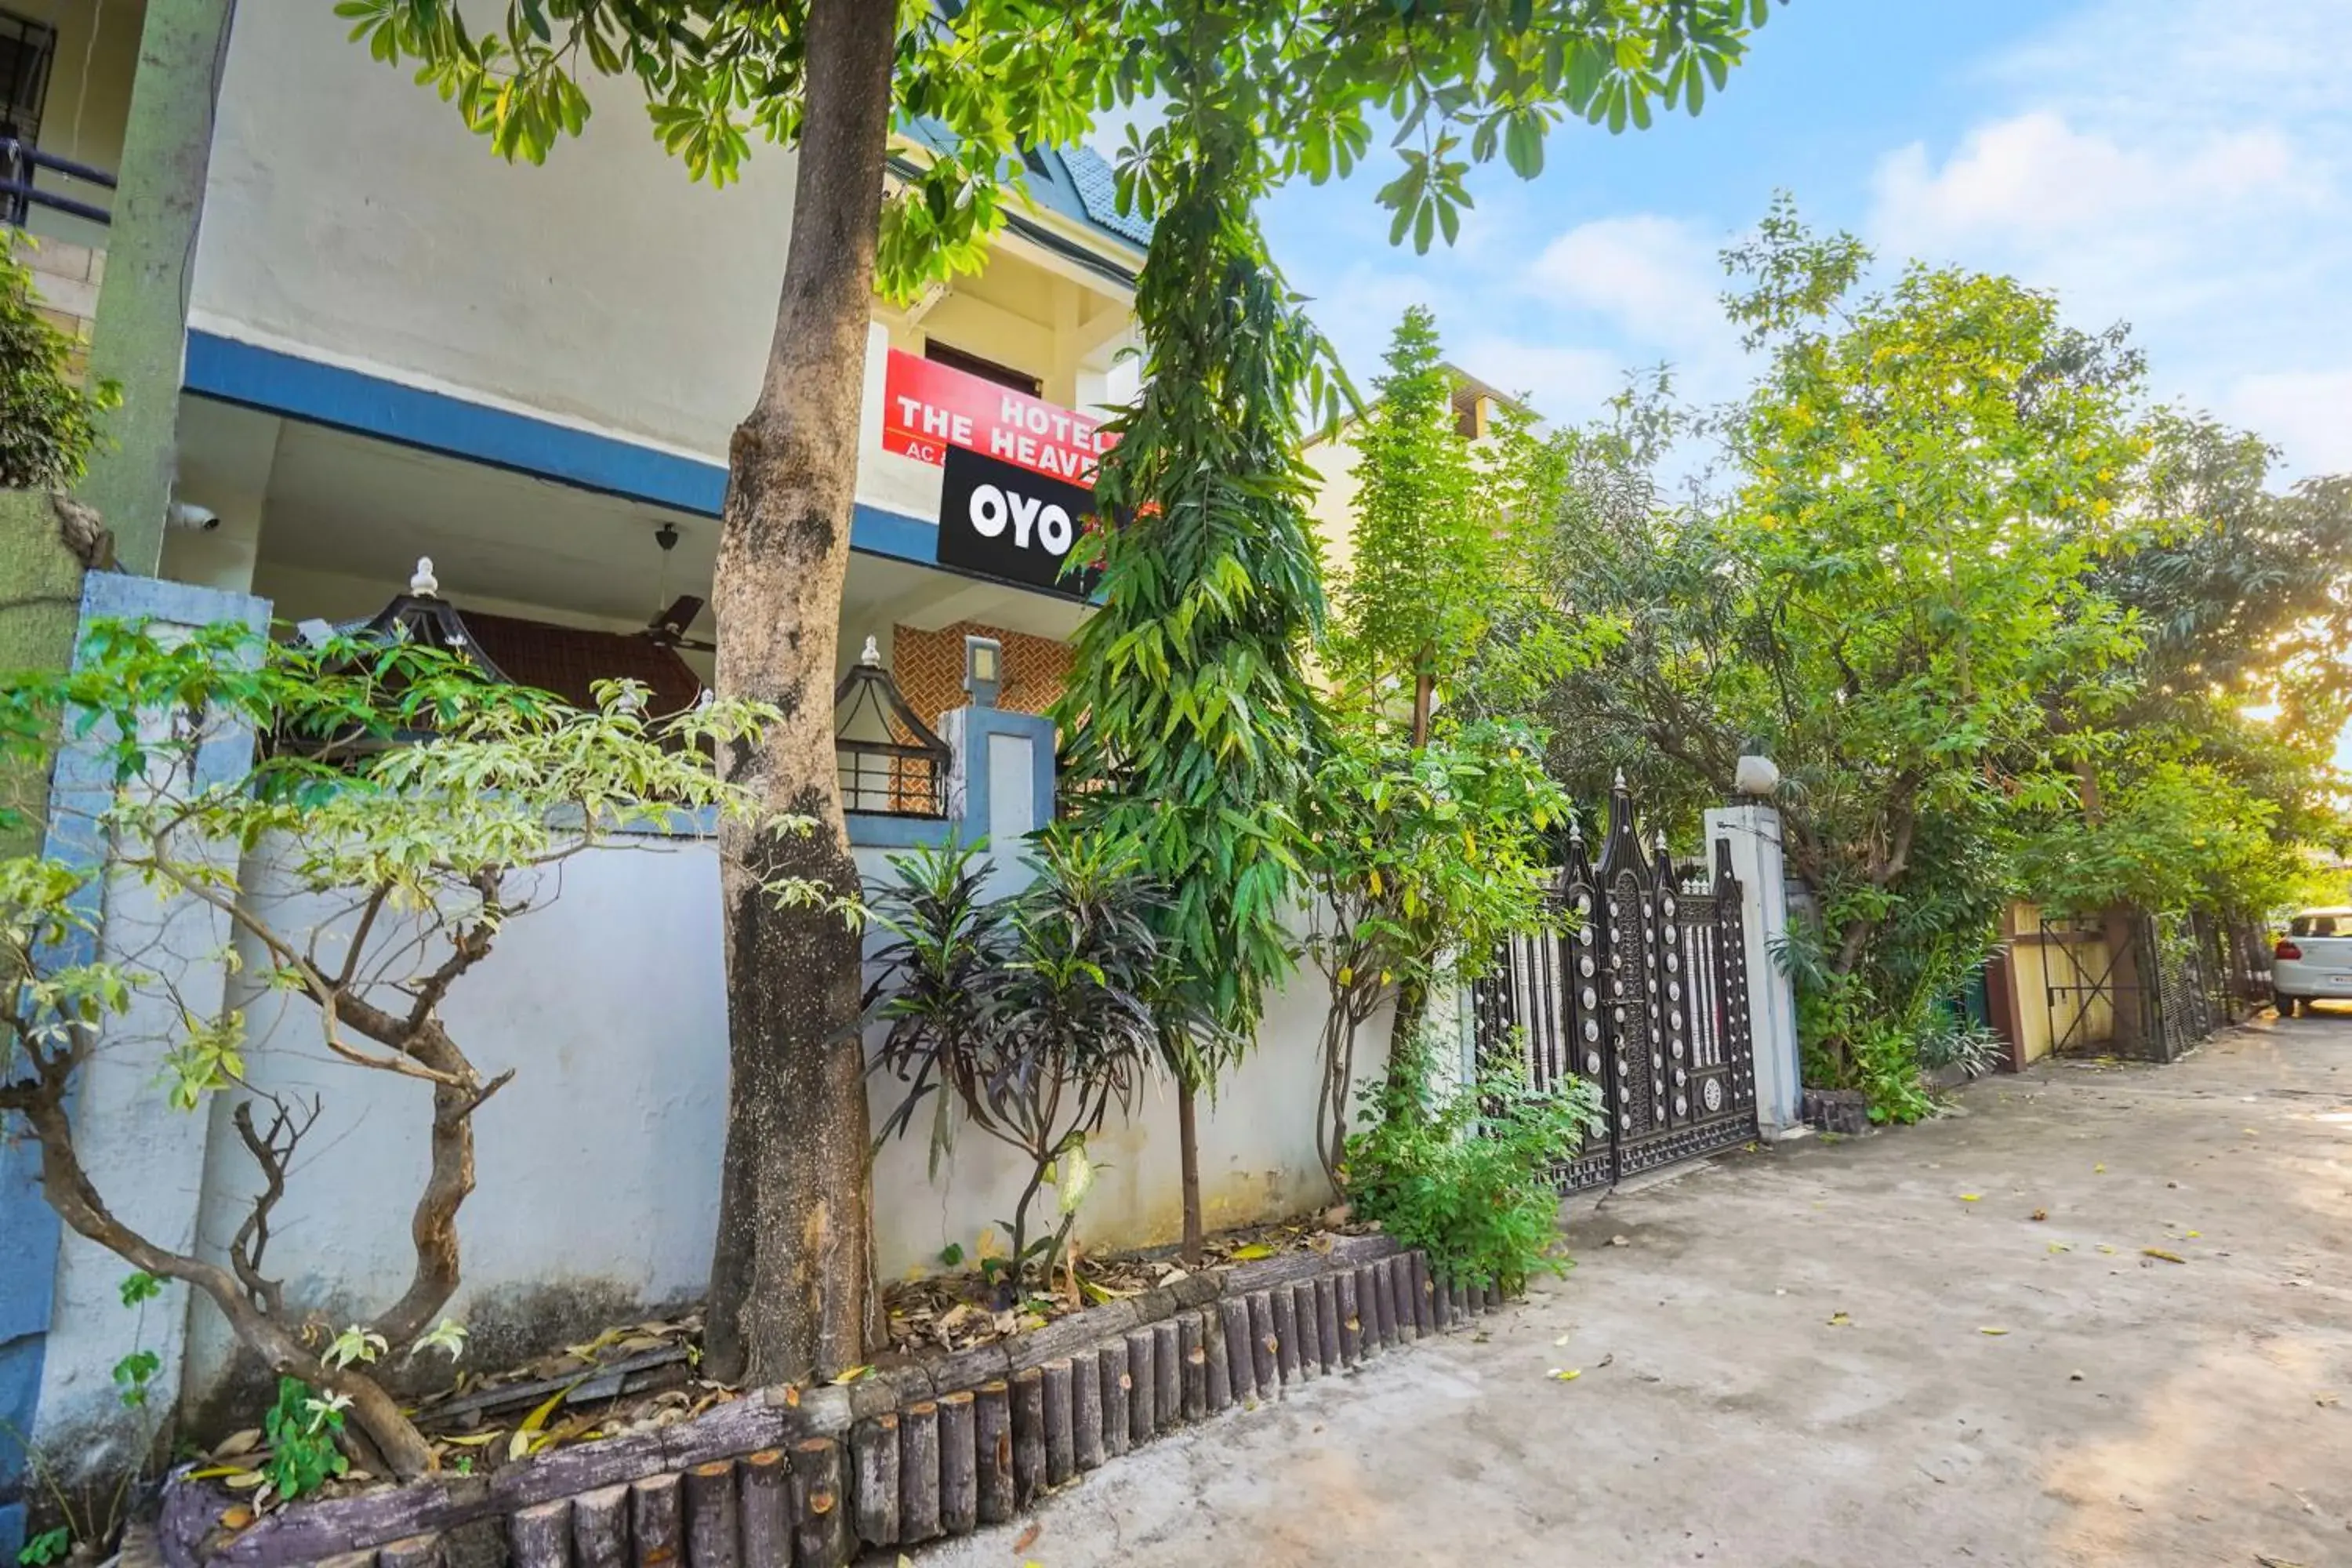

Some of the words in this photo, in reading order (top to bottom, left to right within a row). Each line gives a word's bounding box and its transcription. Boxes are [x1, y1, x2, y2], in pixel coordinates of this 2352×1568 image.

[897, 395, 973, 446] THE
[991, 426, 1099, 485] HEAVE
[906, 442, 935, 462] AC
[1001, 394, 1105, 454] HOTEL
[969, 484, 1073, 556] OYO
